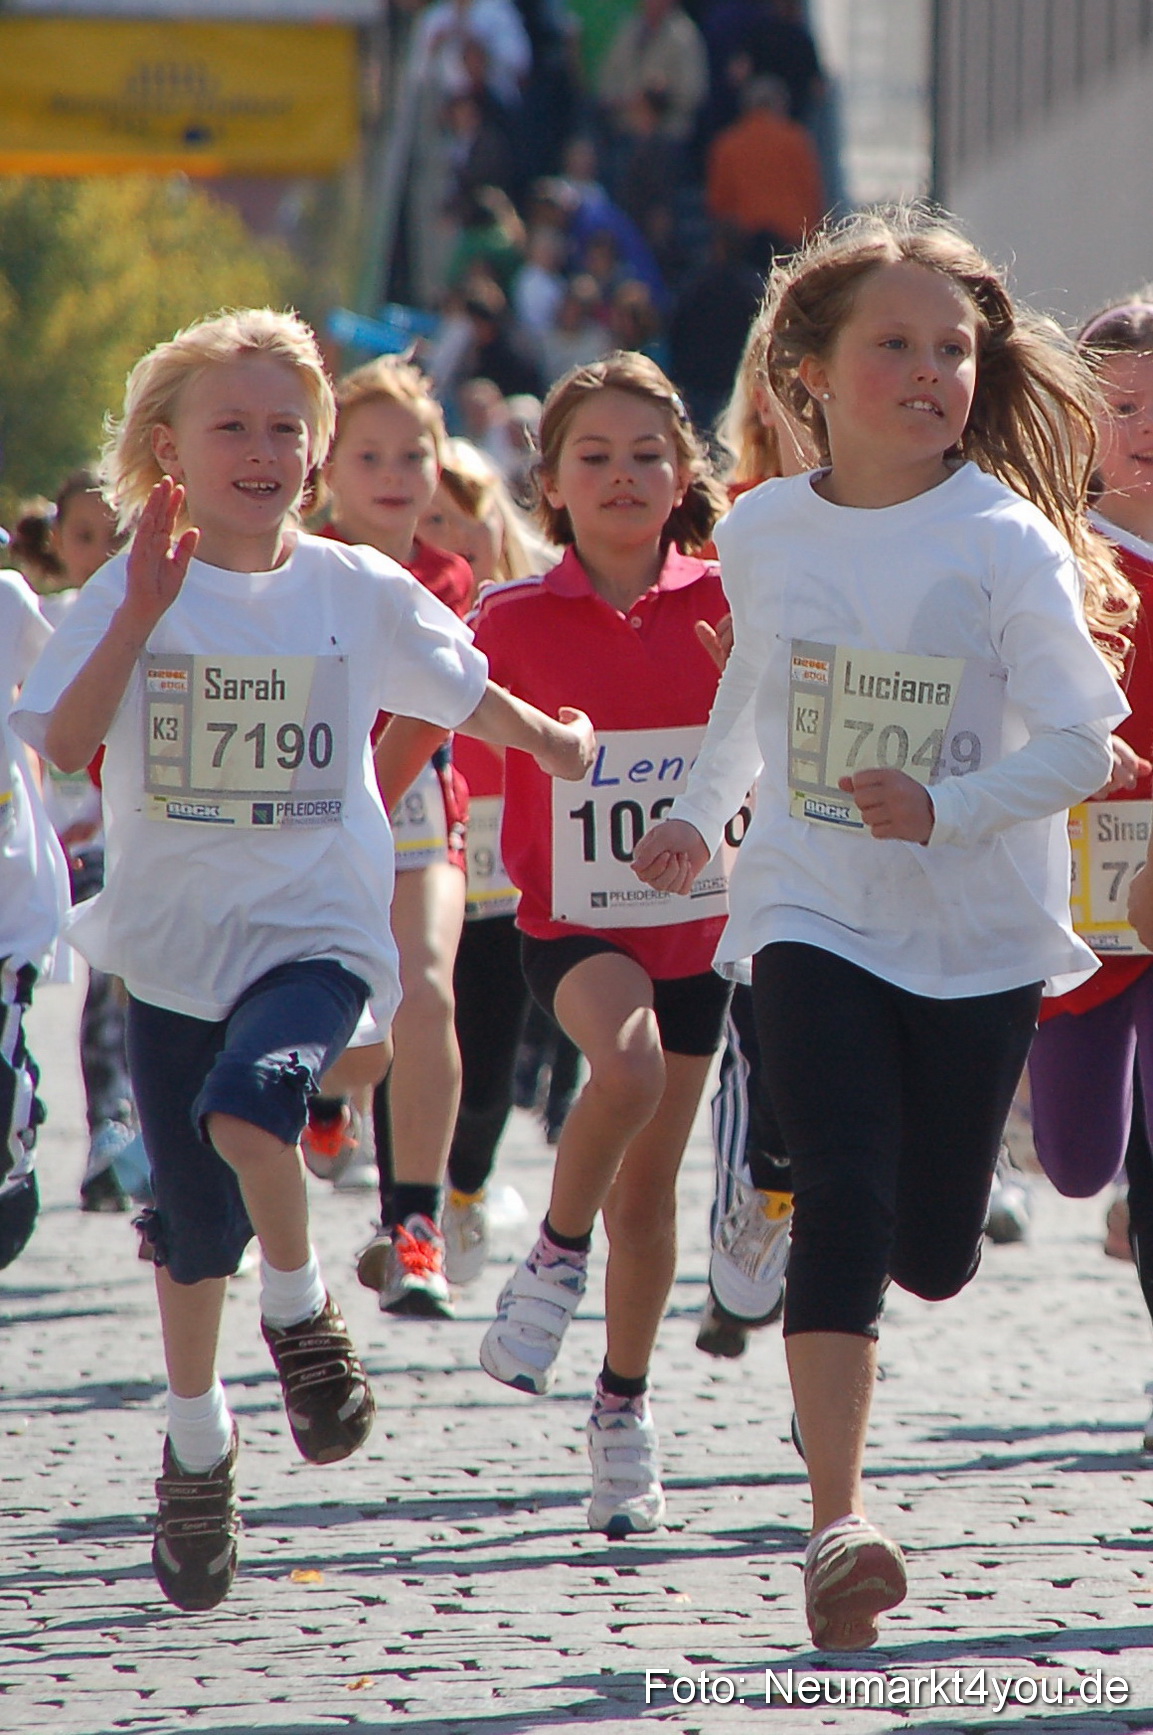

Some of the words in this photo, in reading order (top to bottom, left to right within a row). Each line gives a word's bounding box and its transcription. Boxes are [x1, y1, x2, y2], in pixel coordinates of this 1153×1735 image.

[205, 667, 285, 700] Sarah
[843, 660, 951, 706] Luciana
[153, 716, 178, 740] K3
[795, 707, 819, 735] K3
[206, 722, 333, 769] 7190
[844, 719, 981, 776] 7049
[1097, 814, 1148, 842] Sina
